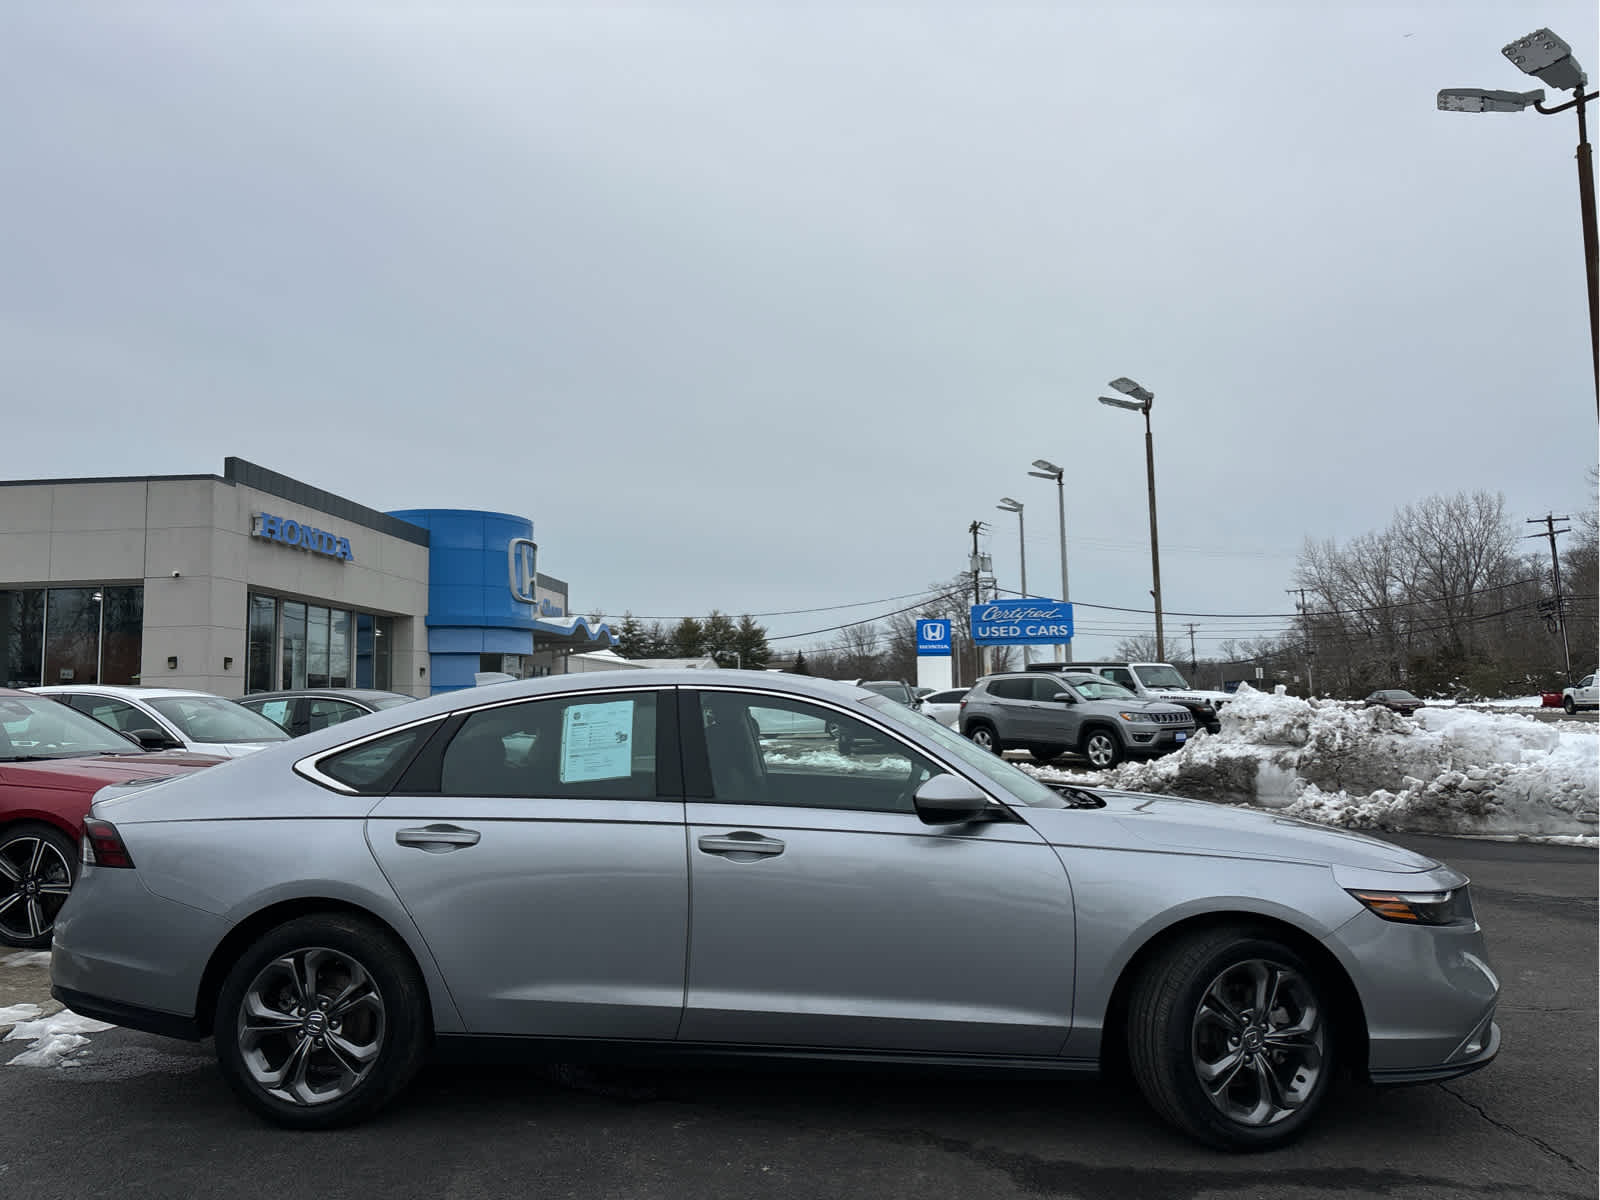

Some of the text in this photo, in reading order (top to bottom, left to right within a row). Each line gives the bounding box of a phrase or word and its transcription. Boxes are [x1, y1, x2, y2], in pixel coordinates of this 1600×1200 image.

[259, 512, 354, 561] HONDA
[982, 606, 1063, 623] Certified
[978, 625, 1068, 637] USED CARS
